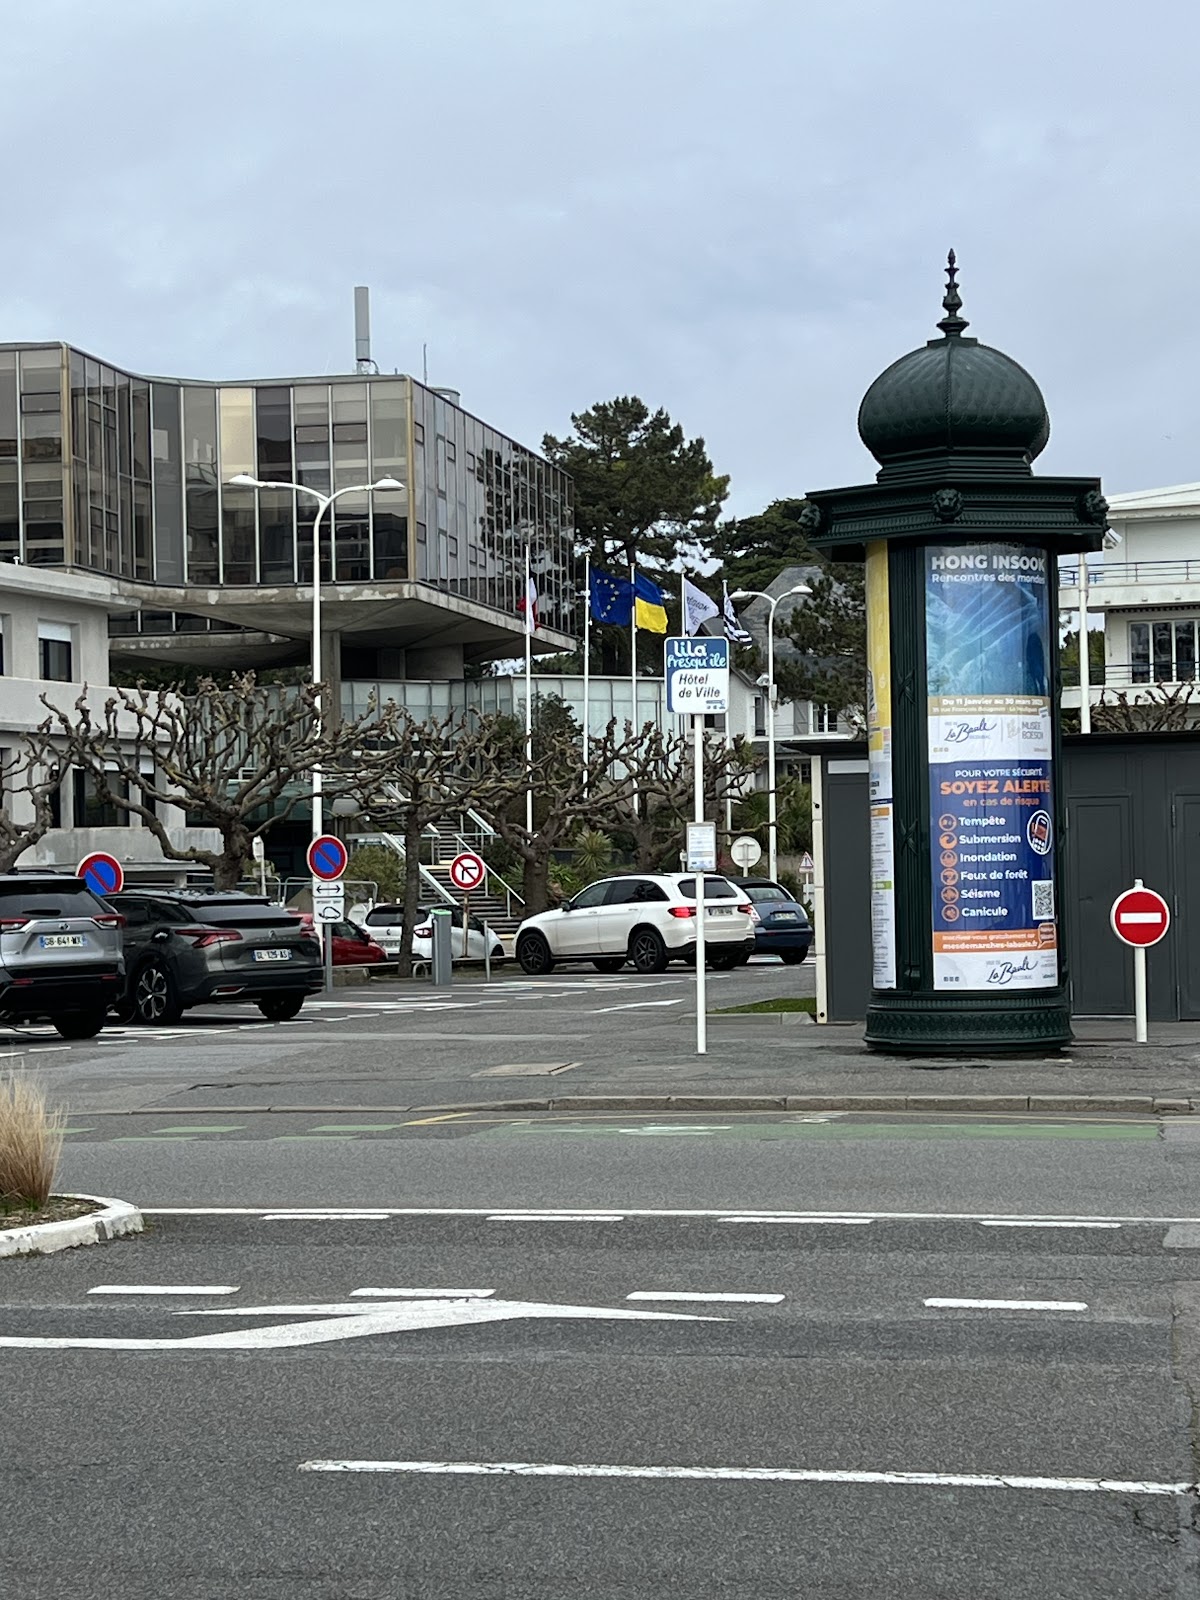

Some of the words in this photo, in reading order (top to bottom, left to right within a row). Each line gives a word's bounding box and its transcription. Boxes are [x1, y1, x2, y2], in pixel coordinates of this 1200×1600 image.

[931, 555, 988, 570] HONG
[992, 555, 1045, 572] INSOOK
[931, 573, 996, 583] Rencontres
[997, 572, 1016, 582] des
[678, 673, 709, 685] Hôtel
[678, 687, 692, 698] de
[695, 686, 721, 698] Ville
[964, 697, 992, 706] janvier
[955, 769, 981, 778] POUR
[983, 768, 1011, 777] VOTRE
[940, 780, 999, 795] SOYEZ
[962, 799, 977, 807] en
[980, 798, 998, 806] cas
[1000, 797, 1013, 806] de
[1015, 797, 1040, 807] risque
[958, 815, 1006, 827] Tempête
[959, 833, 1021, 844] Submersion
[960, 851, 1017, 862] Inondation
[960, 871, 987, 880] Feux
[989, 870, 1003, 880] de
[1005, 869, 1028, 879] forêt
[960, 889, 1000, 899] Séisme
[961, 906, 1008, 917] Canicule
